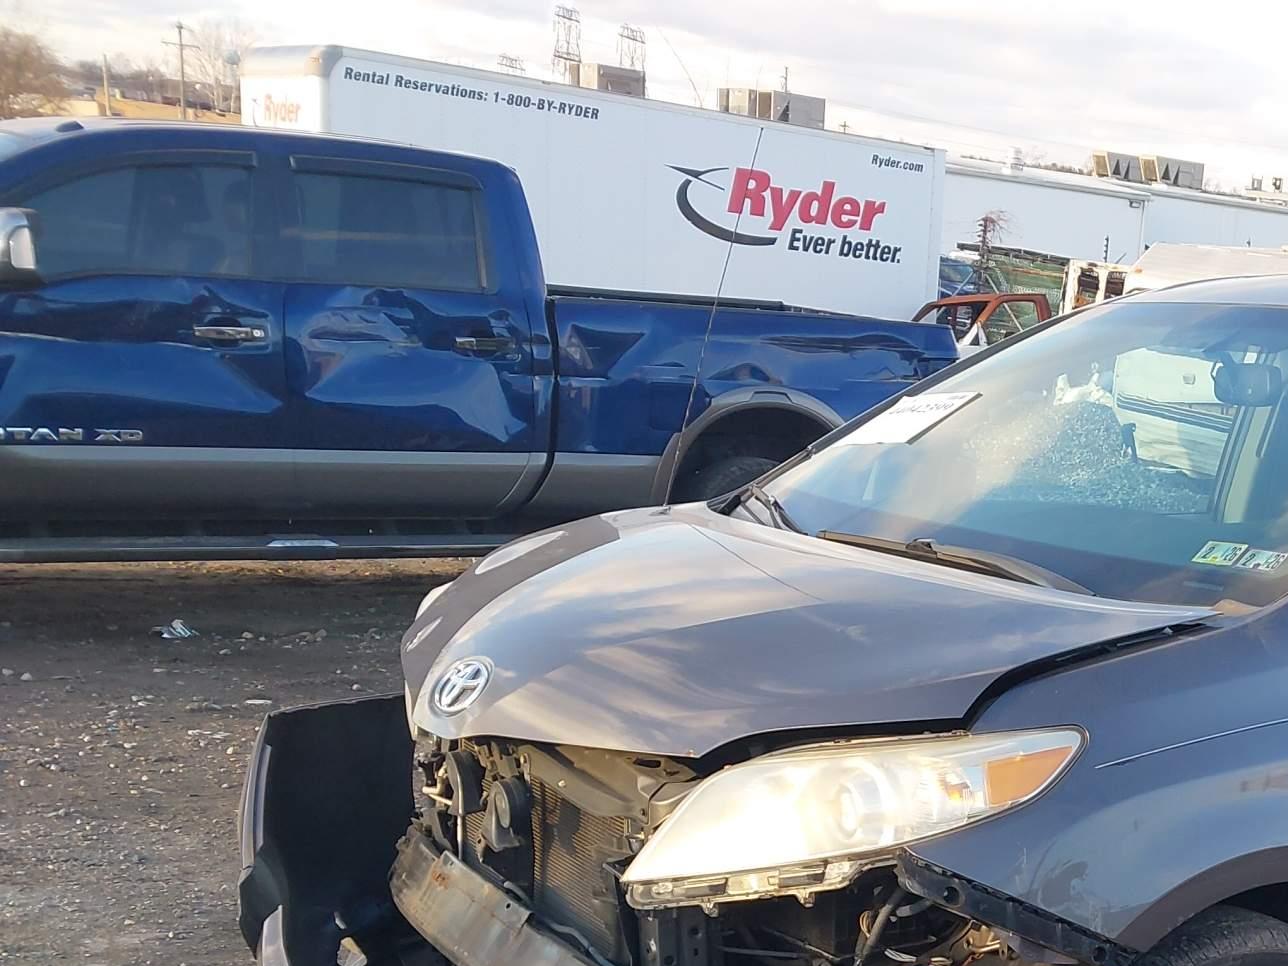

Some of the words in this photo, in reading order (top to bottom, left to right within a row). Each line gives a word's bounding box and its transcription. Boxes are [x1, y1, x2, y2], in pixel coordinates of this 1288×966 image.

[343, 67, 390, 86] Rental
[394, 75, 488, 102] Reservations:
[493, 91, 600, 120] 1-800-BY-RYDER
[871, 154, 924, 173] Ryder.com
[727, 167, 886, 231] Ryder
[788, 228, 836, 255] Ever
[839, 234, 902, 264] better.
[94, 428, 143, 442] XD
